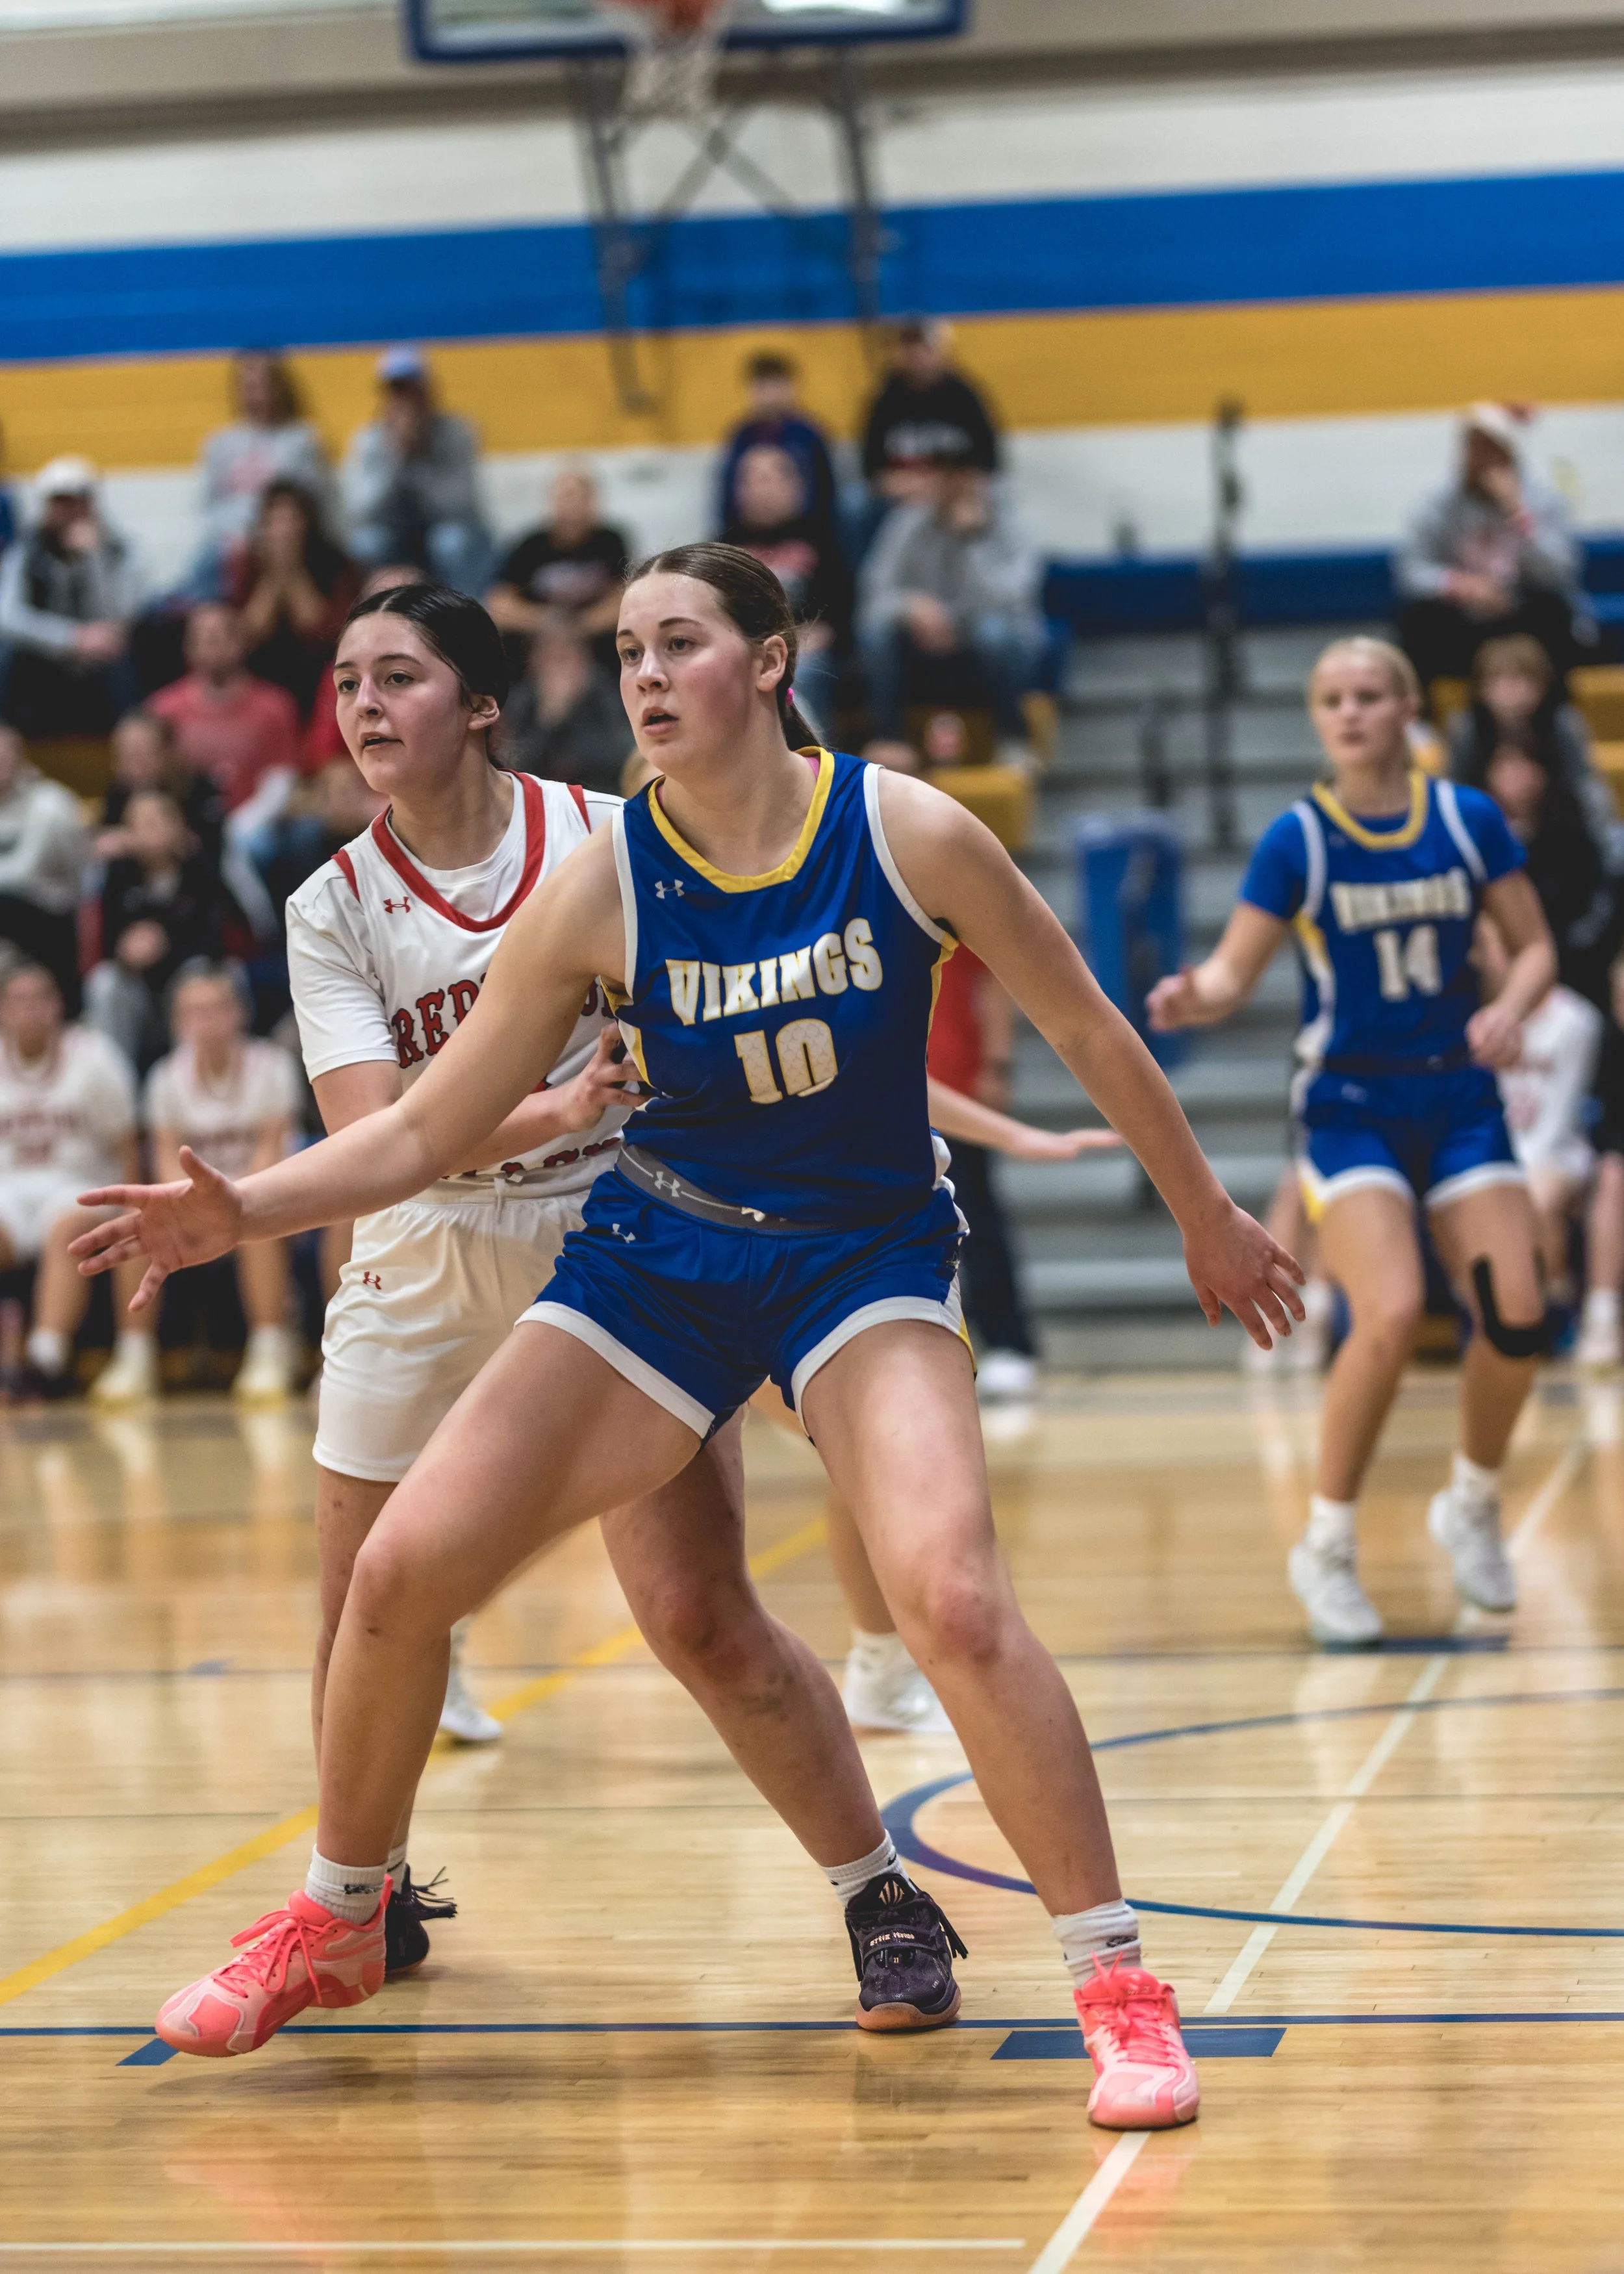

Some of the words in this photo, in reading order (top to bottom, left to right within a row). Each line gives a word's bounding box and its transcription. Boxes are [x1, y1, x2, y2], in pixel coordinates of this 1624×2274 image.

[665, 917, 883, 1026] VIKINGS
[1373, 925, 1441, 1002] 14
[734, 1017, 839, 1105] 10
